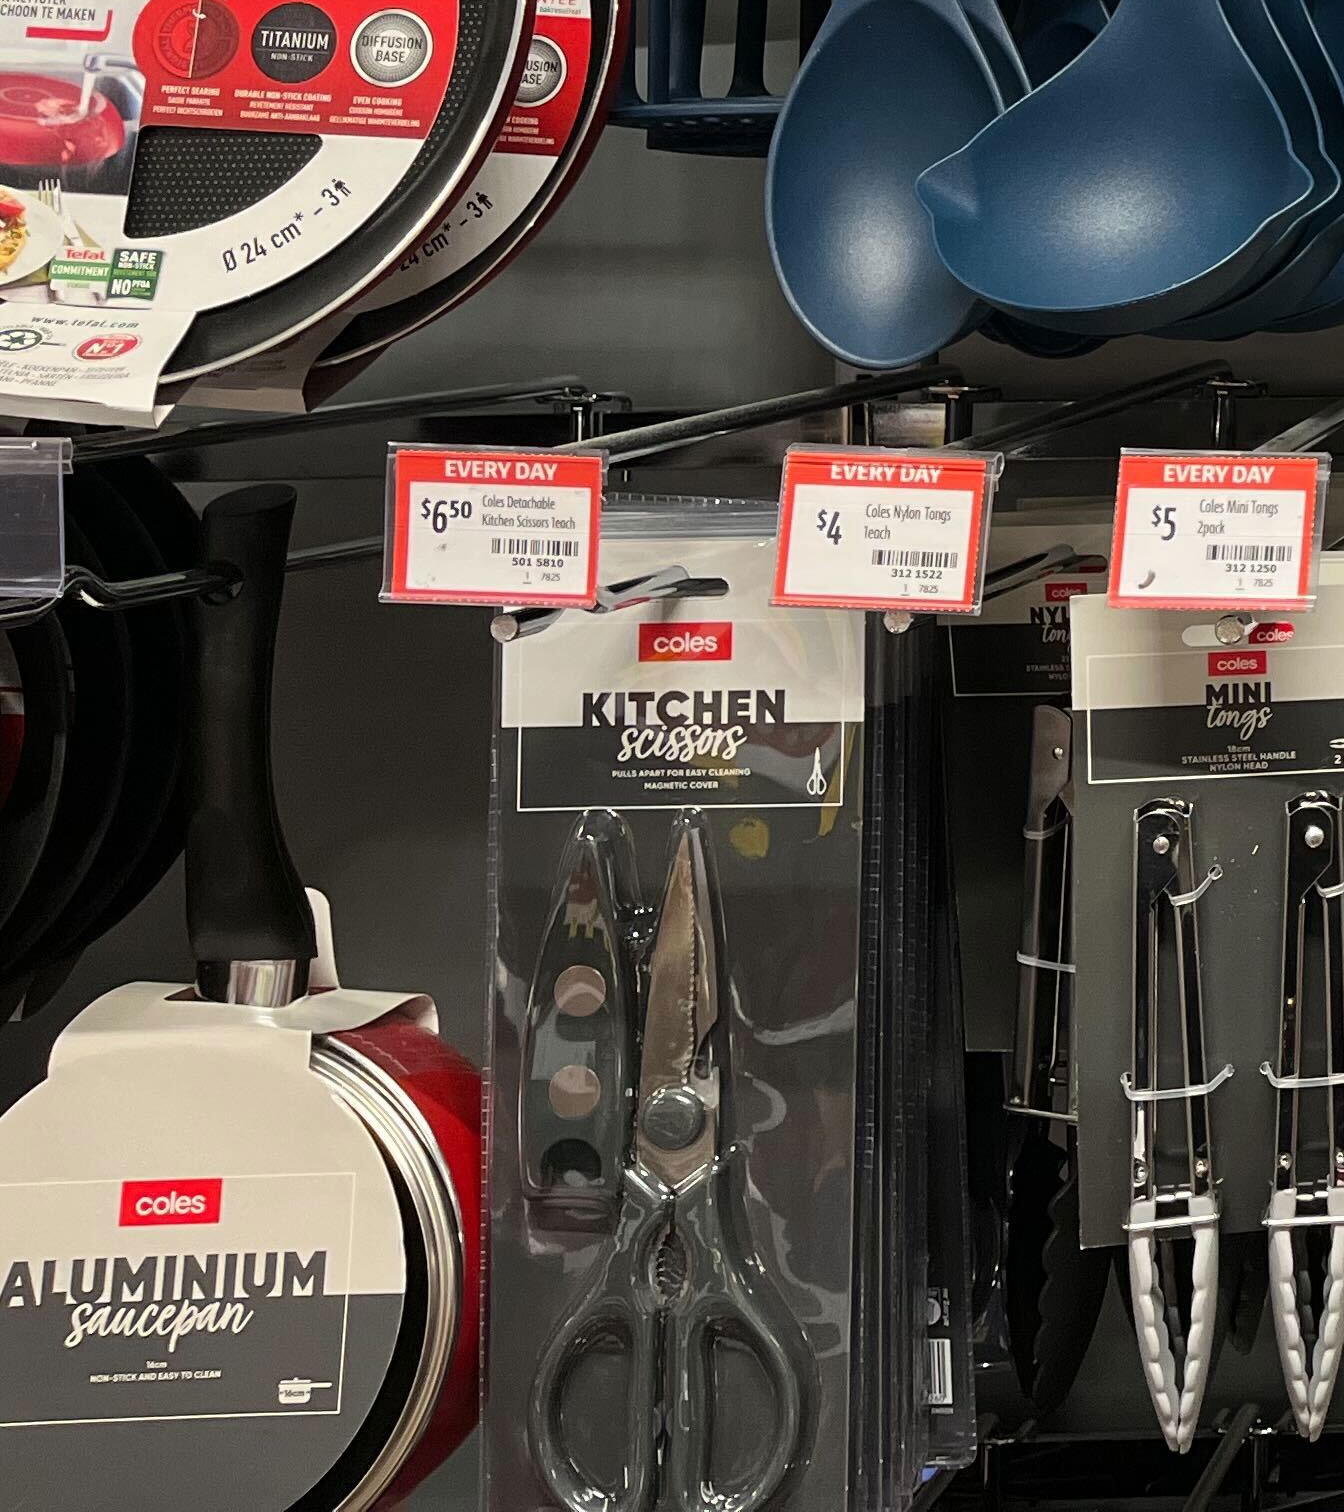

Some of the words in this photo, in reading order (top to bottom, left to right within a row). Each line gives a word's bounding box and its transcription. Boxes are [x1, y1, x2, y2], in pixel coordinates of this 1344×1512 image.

[260, 30, 330, 51] TITANIUM
[361, 35, 424, 52] DIFFUSION
[375, 50, 406, 64] BASE
[445, 460, 510, 478] EVERY
[515, 462, 558, 481] DAY
[830, 462, 897, 481] EVERY
[901, 464, 944, 484] DAY
[1163, 464, 1227, 483] EVERY
[1232, 466, 1275, 484] DAY
[482, 494, 505, 508] Coles
[507, 496, 555, 510] Detachable
[482, 514, 515, 527] Kitchen
[516, 515, 549, 529] Scissors
[816, 509, 842, 545] $4
[1152, 505, 1176, 541] $5
[654, 633, 717, 653] coles
[1216, 655, 1258, 673] coles
[1205, 682, 1272, 705] MINI
[582, 689, 785, 728] KITCHEN
[1205, 706, 1273, 741] tongs
[617, 725, 747, 762] scissors
[1333, 753, 1341, 764] 2
[135, 1191, 207, 1217] coles
[1, 1251, 327, 1308] ALUMINIUM
[64, 1298, 253, 1353] saucepan
